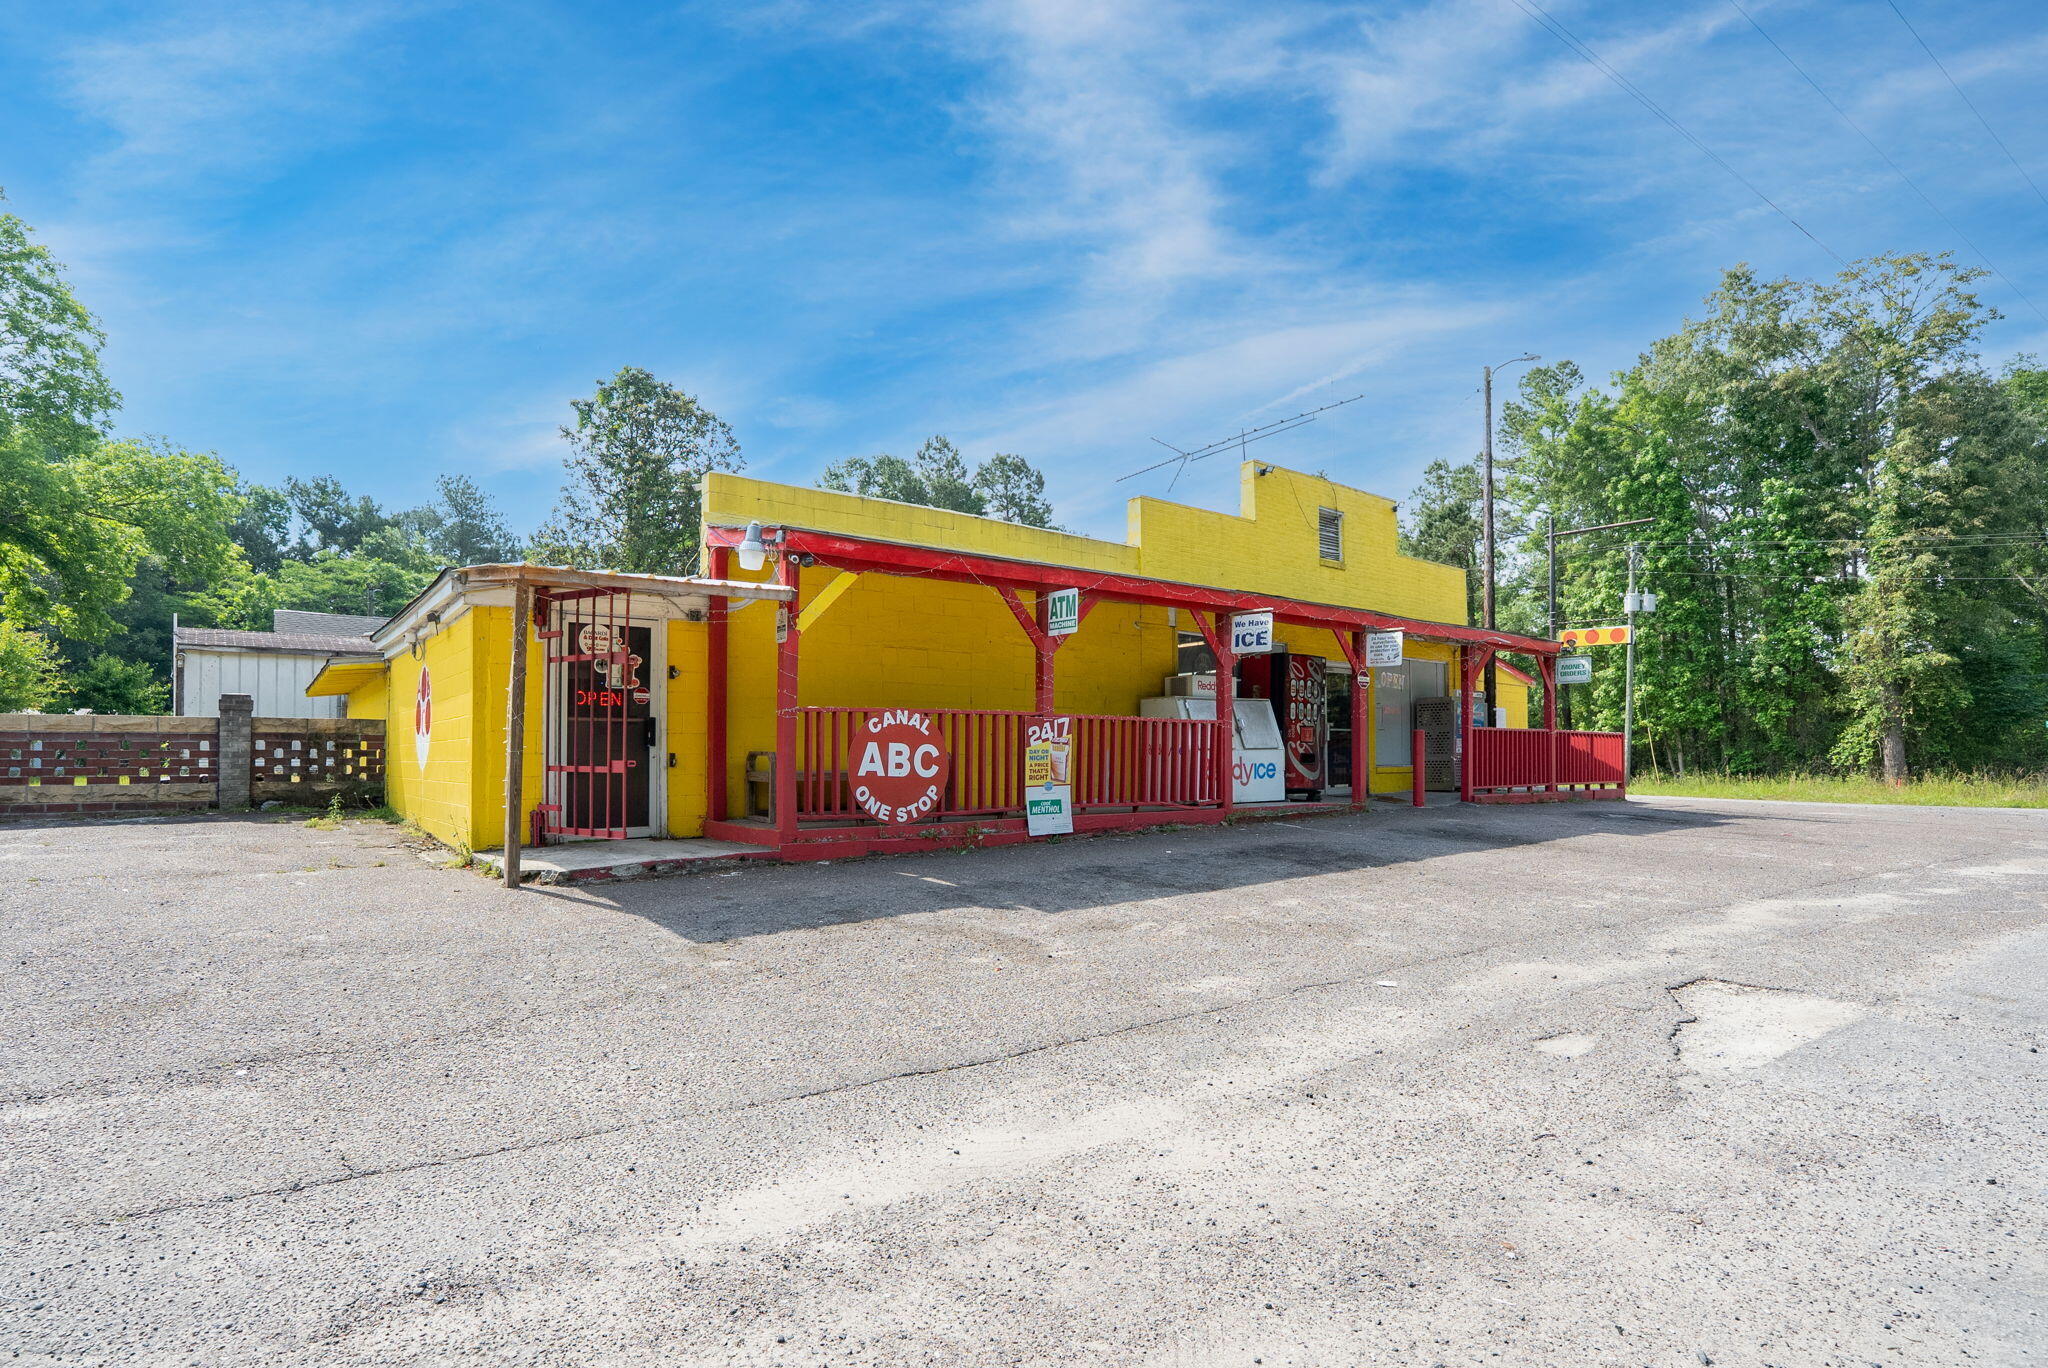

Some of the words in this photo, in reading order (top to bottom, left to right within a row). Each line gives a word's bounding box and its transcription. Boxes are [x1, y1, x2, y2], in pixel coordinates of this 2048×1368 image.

[1050, 594, 1076, 620] ATM
[1050, 620, 1076, 629] MACHINE
[1235, 630, 1268, 648] ICE
[1561, 663, 1585, 671] MONEY
[1197, 681, 1217, 692] Redd
[577, 690, 622, 706] OPEN
[868, 709, 931, 736] CANAL
[857, 741, 940, 778] ABC
[855, 785, 892, 821] ONE
[896, 784, 938, 822] STOP
[1031, 805, 1060, 814] MENTHOL
